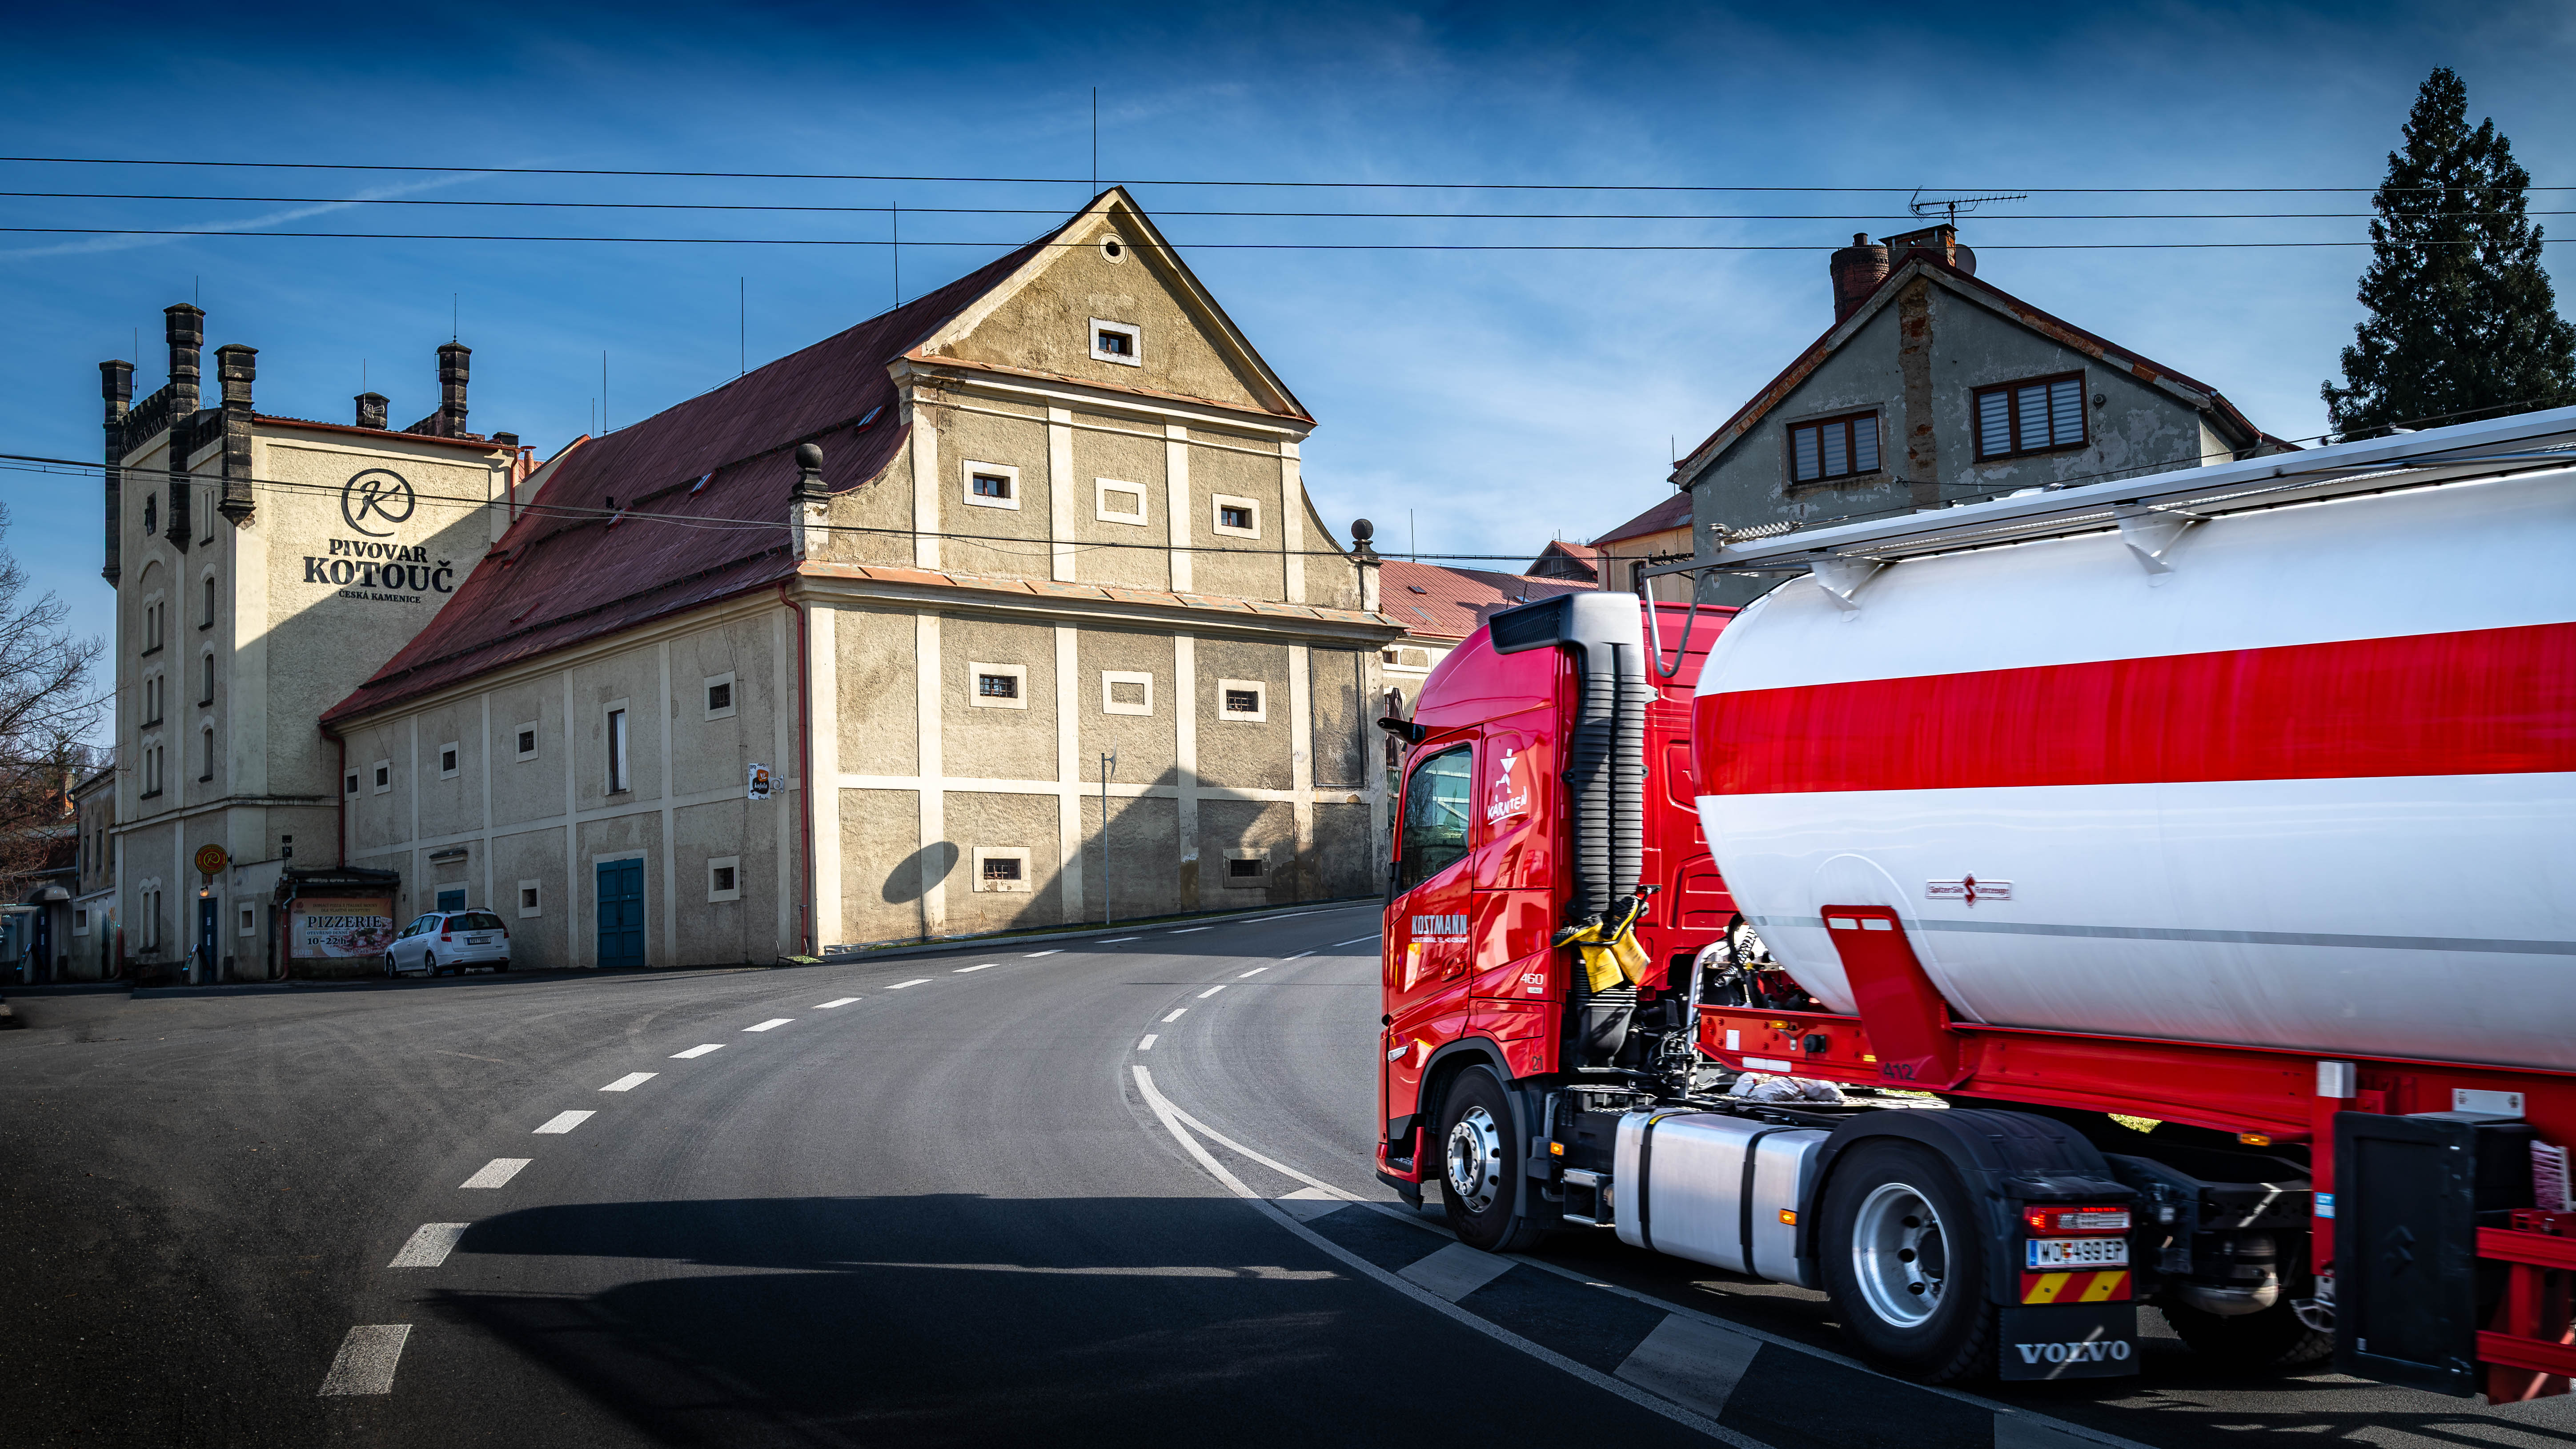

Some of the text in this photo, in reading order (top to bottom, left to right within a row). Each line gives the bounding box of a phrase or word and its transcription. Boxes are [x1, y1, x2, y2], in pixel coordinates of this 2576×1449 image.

[329, 538, 428, 563] PIVOVAR
[303, 556, 453, 593] KOTOUČ
[339, 589, 421, 603] ČESKÁ KAMENICE
[307, 916, 381, 928] PIZZERIE
[1412, 915, 1467, 935] KOSTMANN
[1520, 973, 1544, 985] 460
[1532, 1055, 1543, 1071] 21
[1884, 1063, 1915, 1080] 412
[2015, 1340, 2131, 1364] VOLVO
